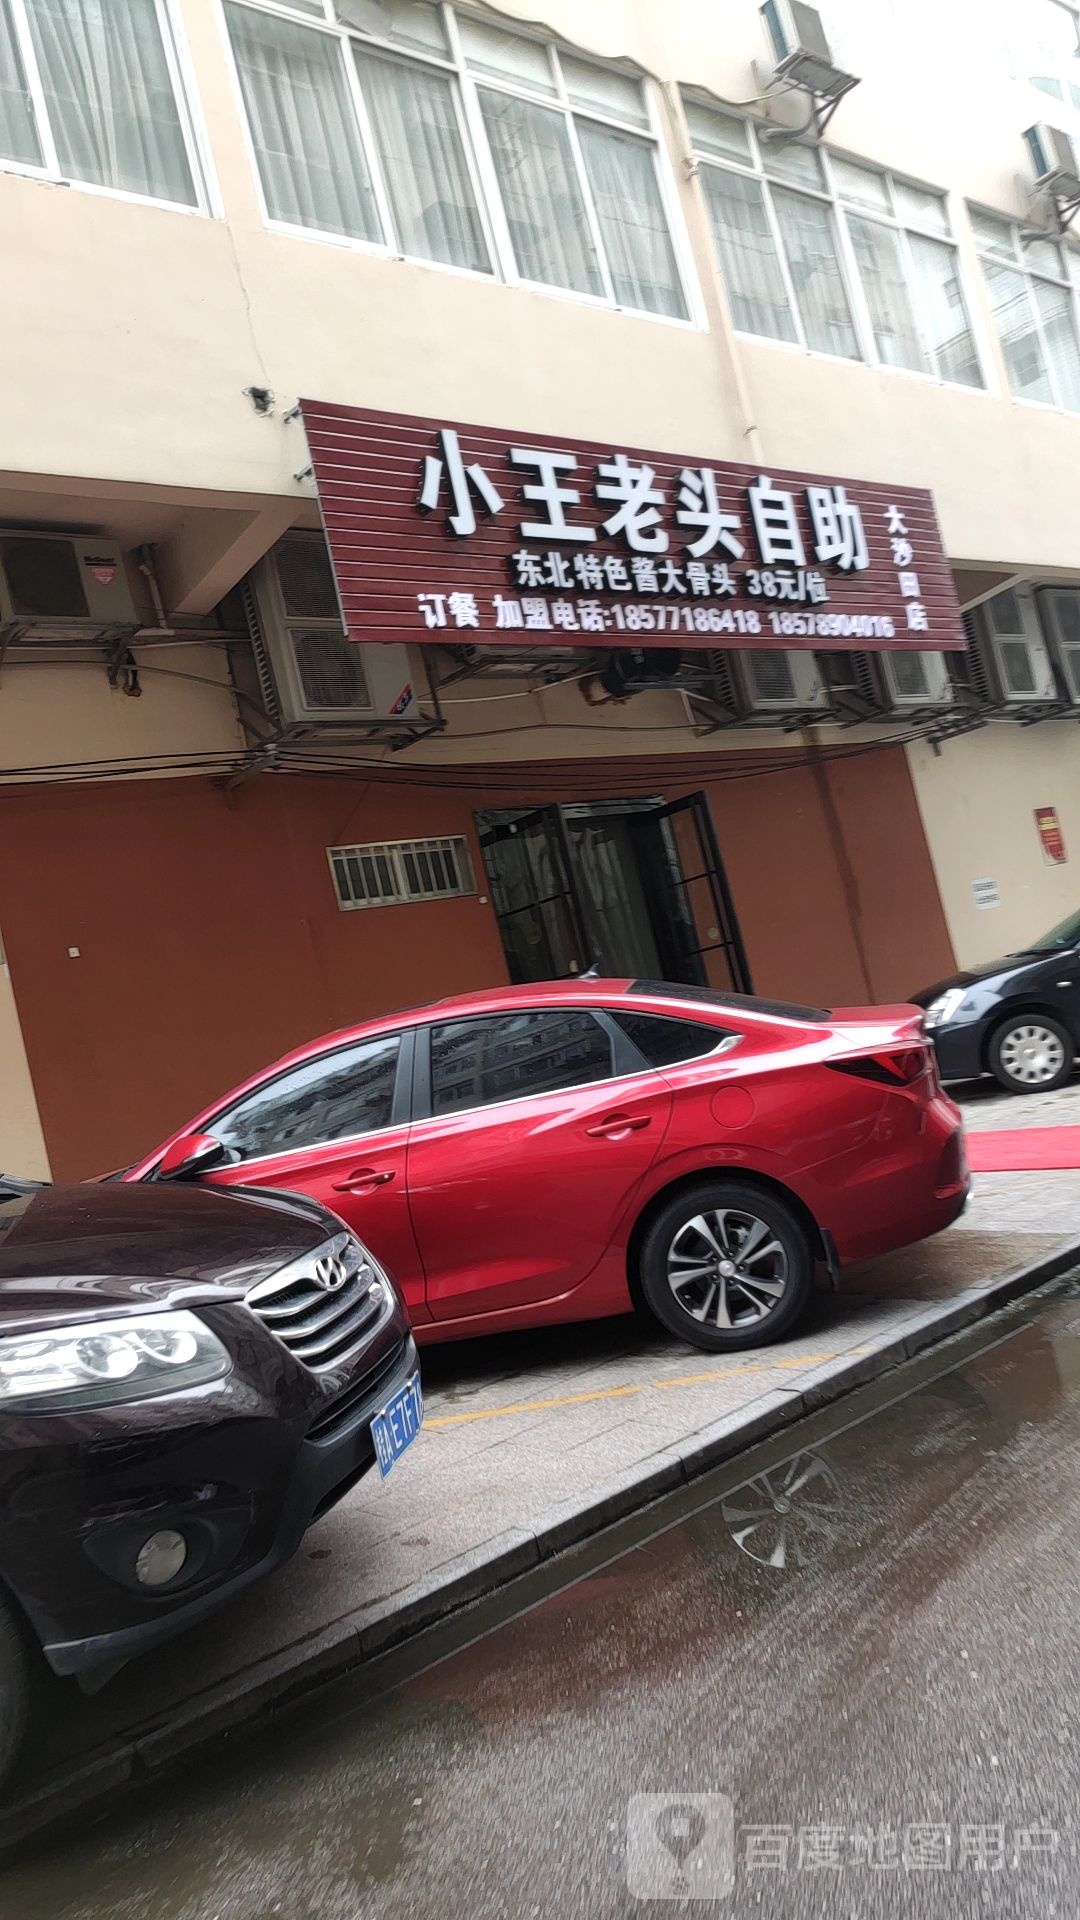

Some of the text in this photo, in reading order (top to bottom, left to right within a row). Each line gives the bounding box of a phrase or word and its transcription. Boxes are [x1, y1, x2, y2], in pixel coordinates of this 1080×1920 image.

[419, 428, 870, 570] 小王老头自助
[512, 549, 737, 596] 东北特色酱大骨头
[417, 592, 479, 629] 订餐
[492, 594, 762, 634] 加盟电话:18577186418
